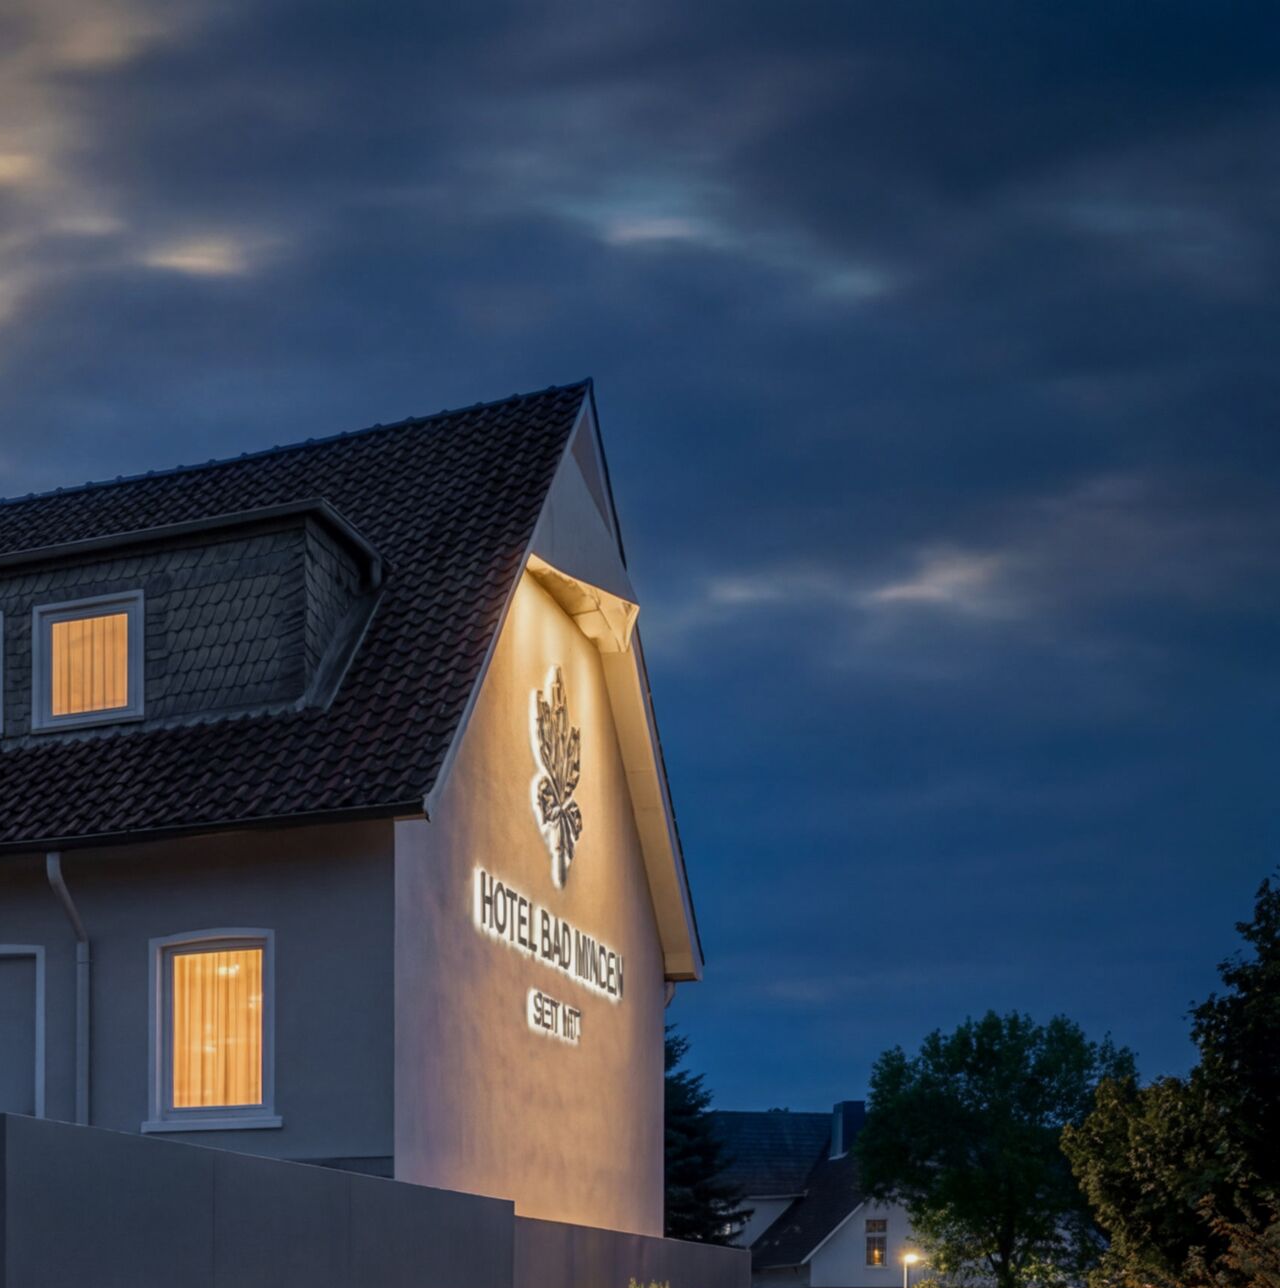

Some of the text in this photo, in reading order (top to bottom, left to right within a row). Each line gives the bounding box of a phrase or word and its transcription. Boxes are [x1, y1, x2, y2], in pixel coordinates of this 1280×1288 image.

[481, 870, 537, 952] HOTEL
[541, 908, 571, 969] BAD
[533, 991, 560, 1034] SEIT
